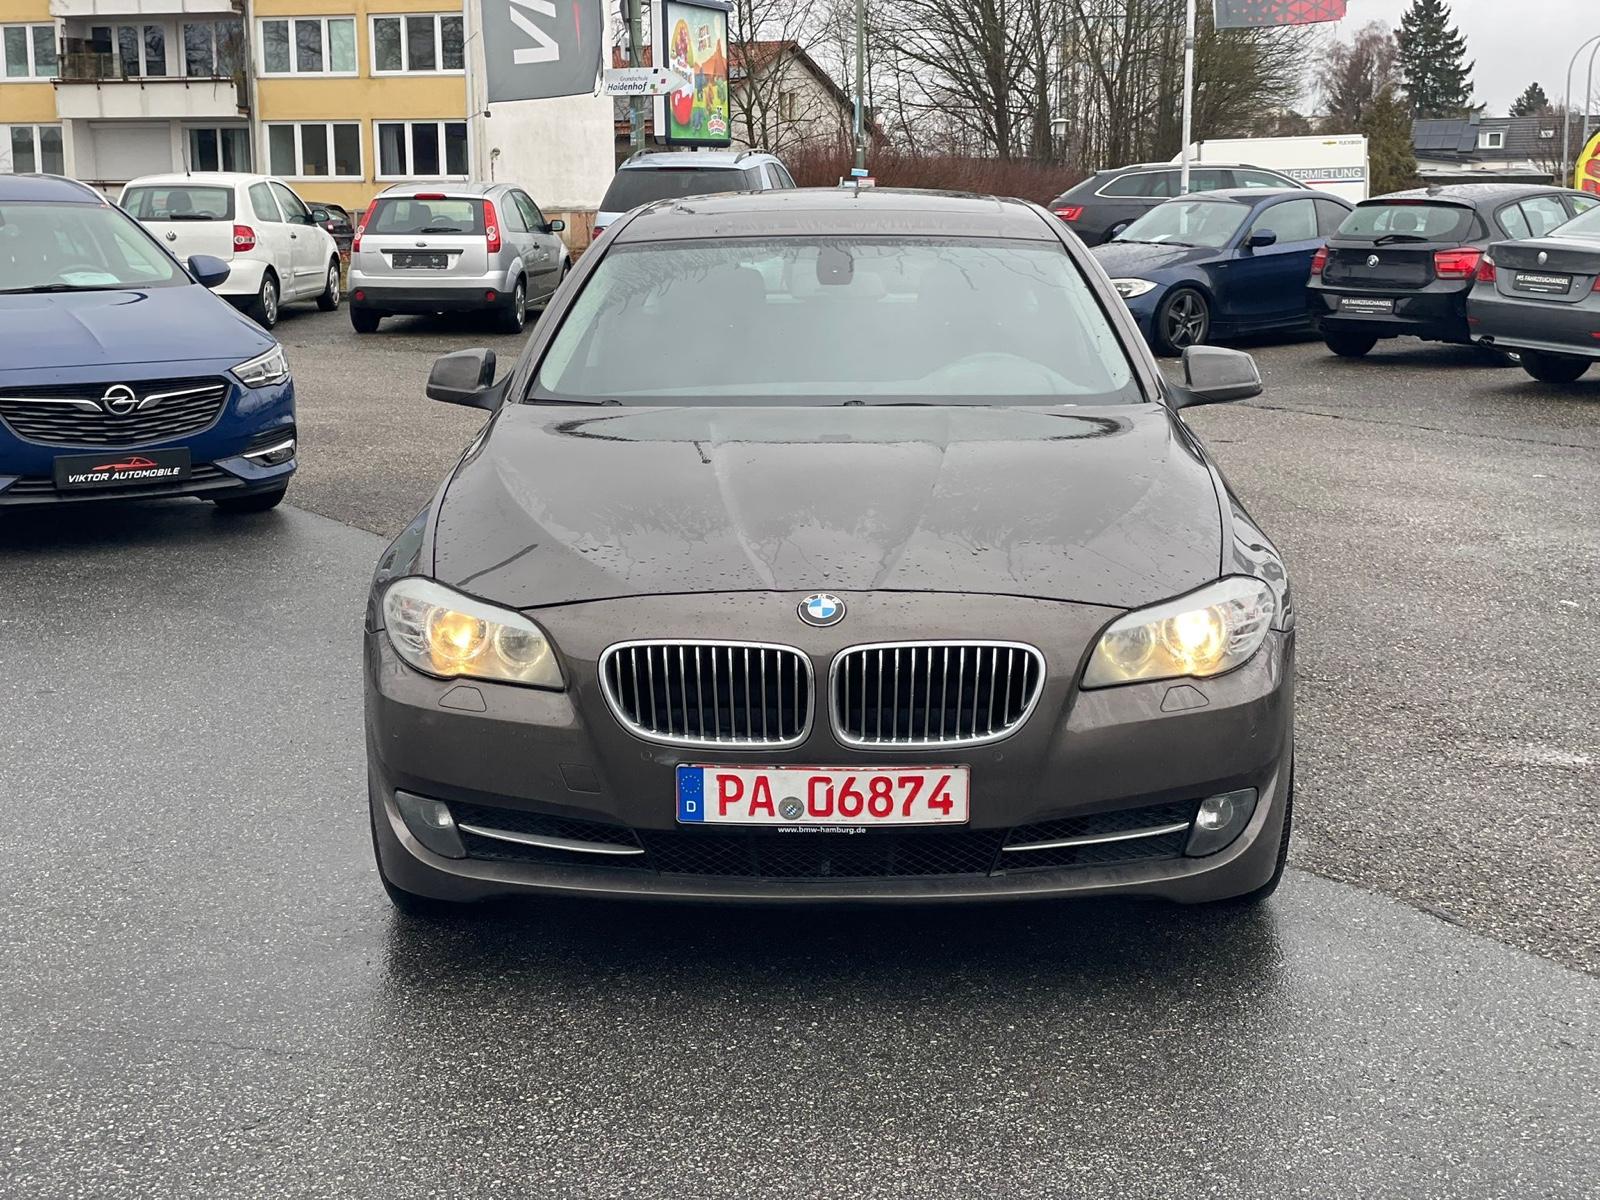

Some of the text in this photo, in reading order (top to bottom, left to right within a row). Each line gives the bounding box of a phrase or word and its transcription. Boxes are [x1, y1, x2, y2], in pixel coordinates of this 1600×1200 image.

[607, 81, 648, 92] Haidenhof
[1278, 167, 1362, 179] VERMIETUNG
[68, 467, 181, 483] VIKTOR AUTOMOBILE
[686, 774, 953, 818] D PA 06874
[778, 826, 867, 835] www.bmw-hamburg.de
